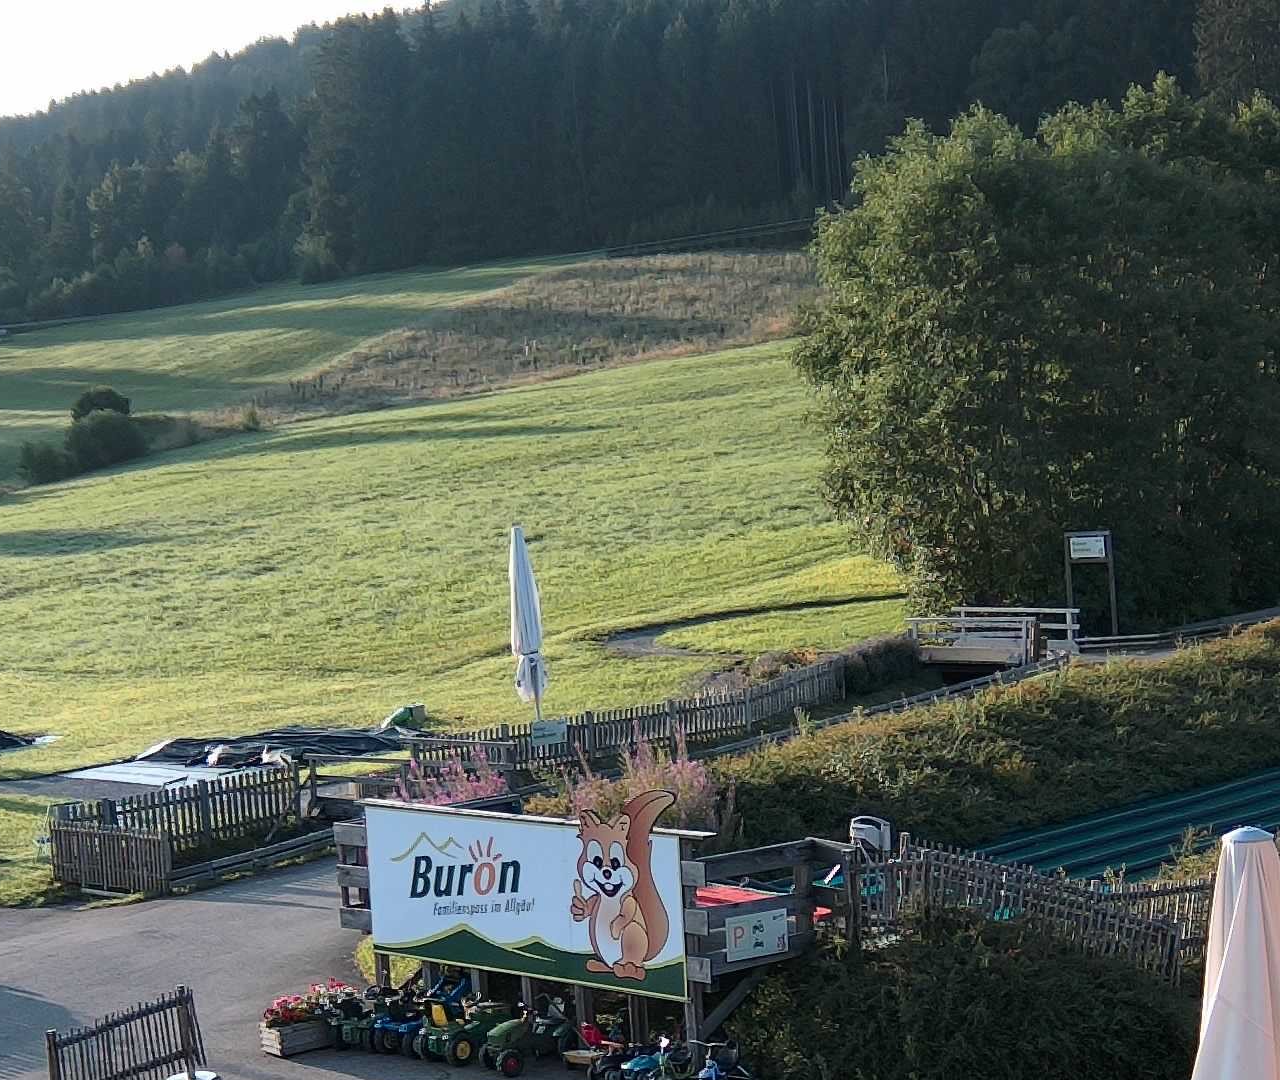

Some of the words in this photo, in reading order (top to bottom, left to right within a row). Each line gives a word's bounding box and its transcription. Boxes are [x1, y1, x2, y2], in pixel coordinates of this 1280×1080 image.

[408, 855, 521, 899] Buron
[491, 901, 502, 913] im
[733, 926, 745, 949] P
